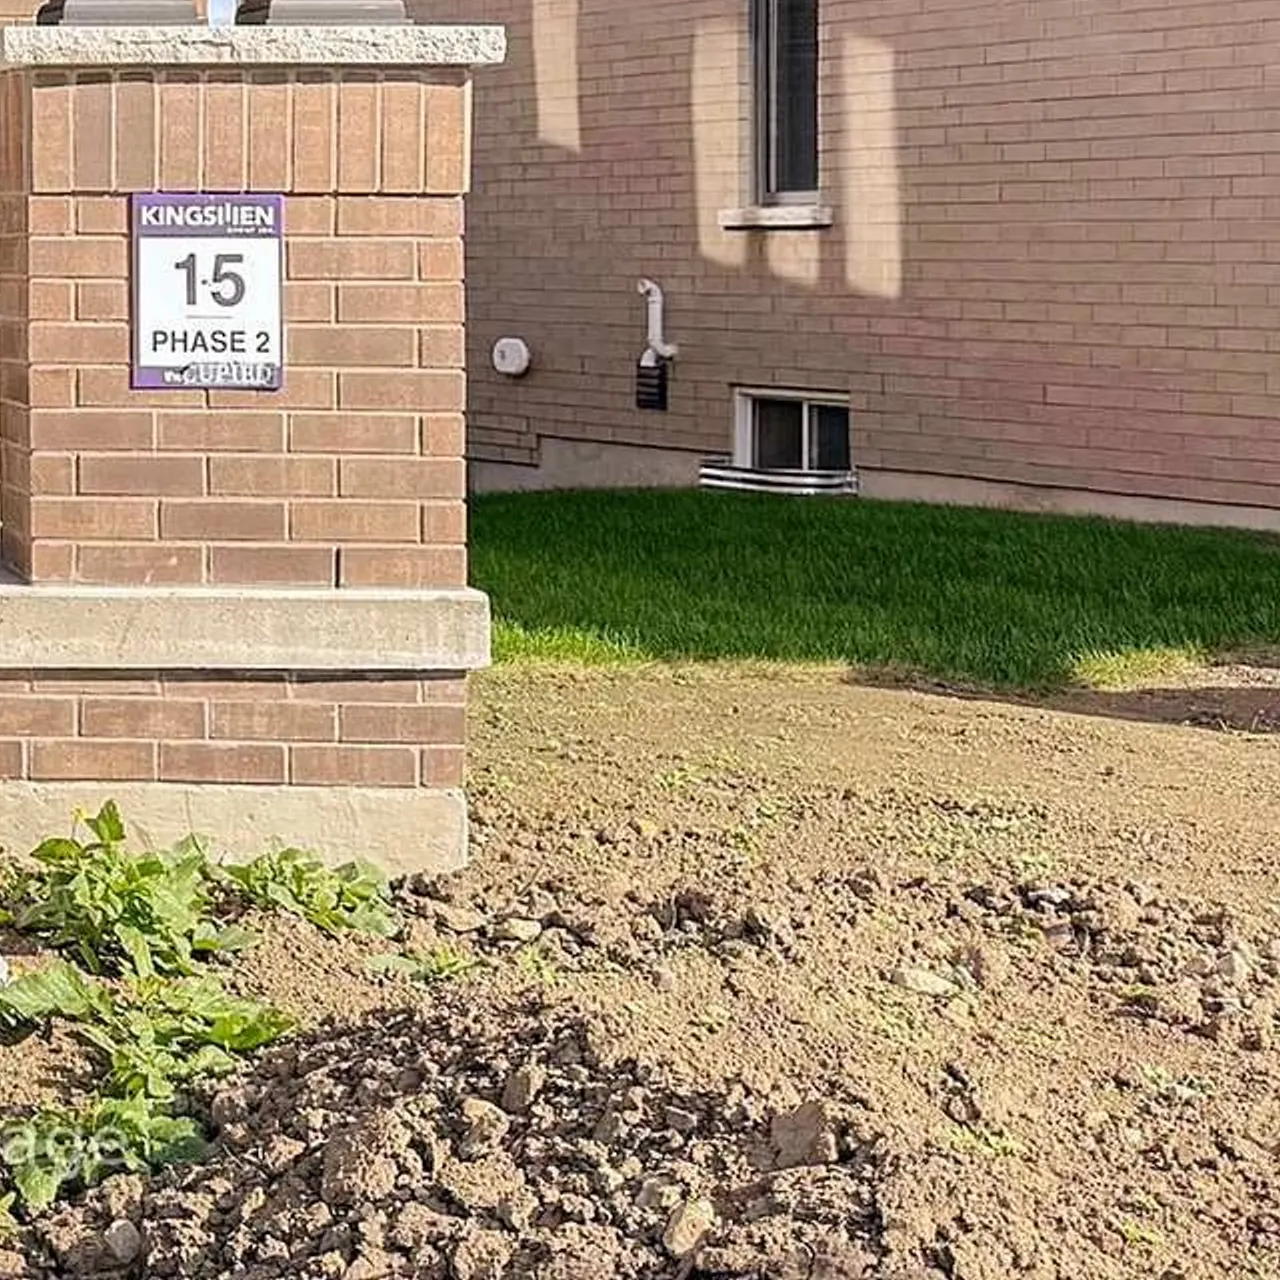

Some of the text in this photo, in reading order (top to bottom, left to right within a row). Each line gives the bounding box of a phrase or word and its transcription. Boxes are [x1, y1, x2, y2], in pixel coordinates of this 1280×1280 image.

[174, 253, 246, 307] 15
[152, 331, 270, 353] PHASE 2
